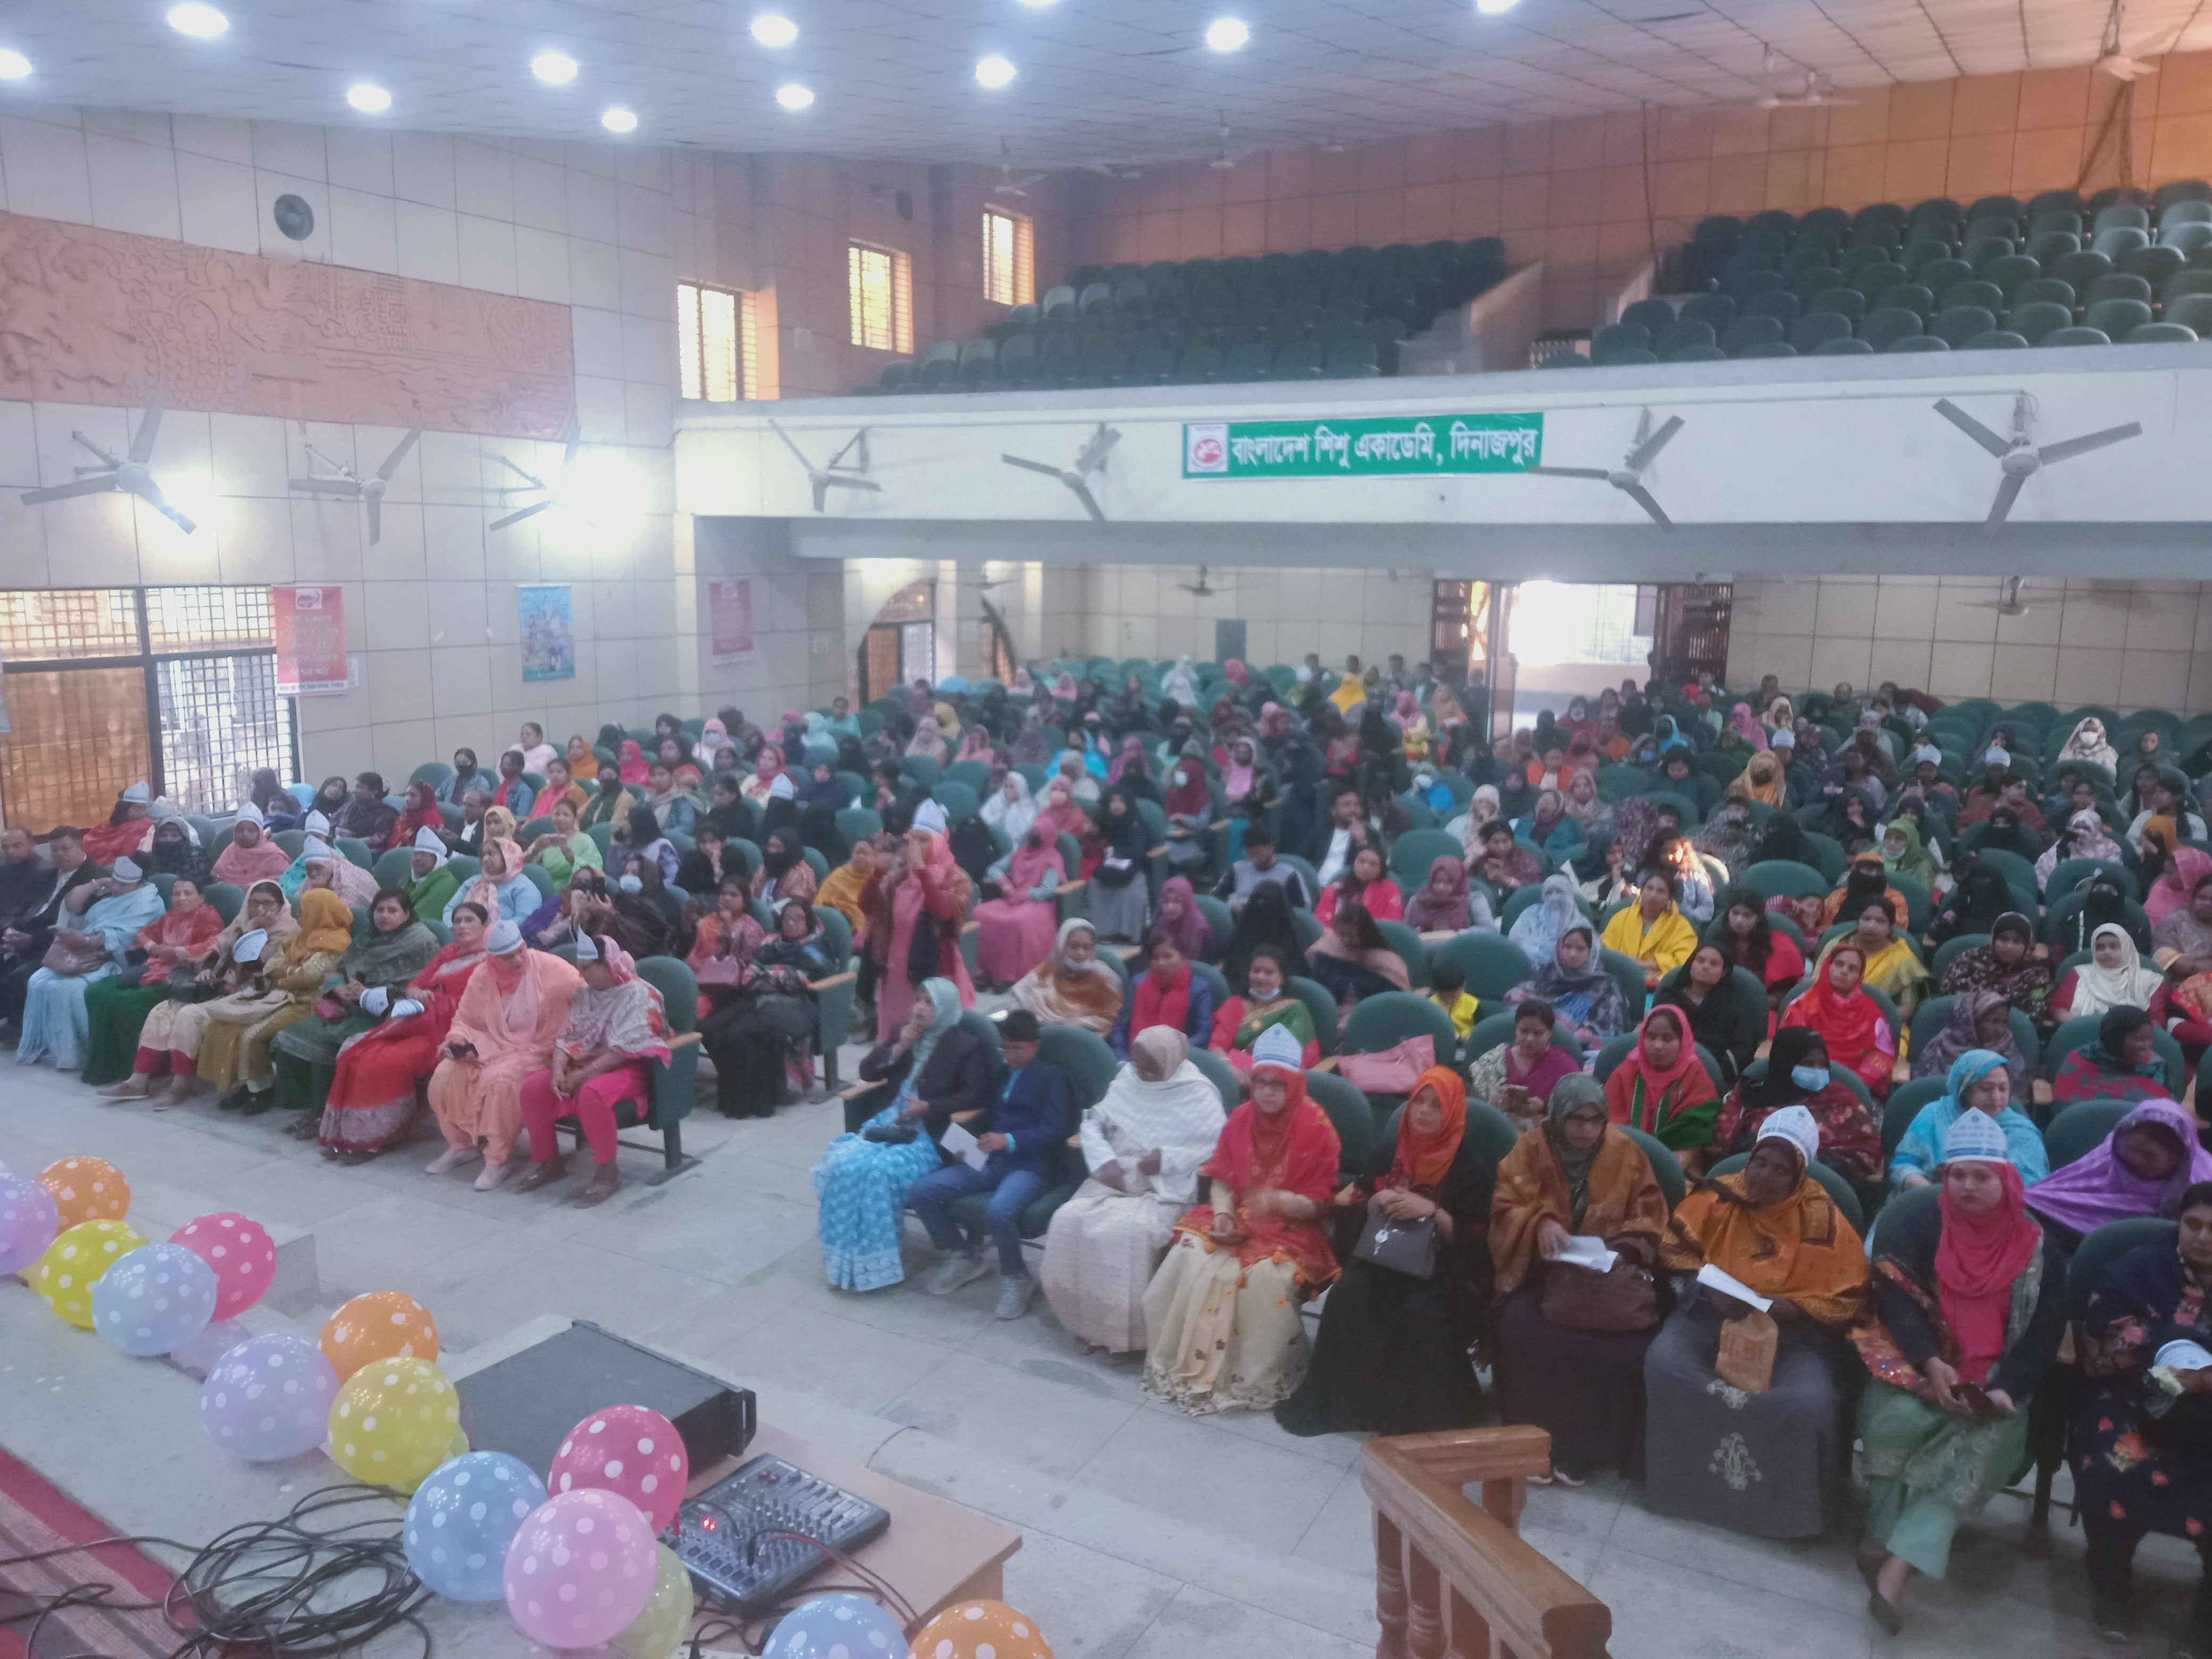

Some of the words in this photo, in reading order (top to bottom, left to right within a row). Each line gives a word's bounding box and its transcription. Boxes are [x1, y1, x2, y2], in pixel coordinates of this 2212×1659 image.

[1231, 432, 1312, 467] বাংলাদেশ
[1313, 425, 1351, 470] শিশু
[1449, 421, 1538, 467] দিনাজপুর
